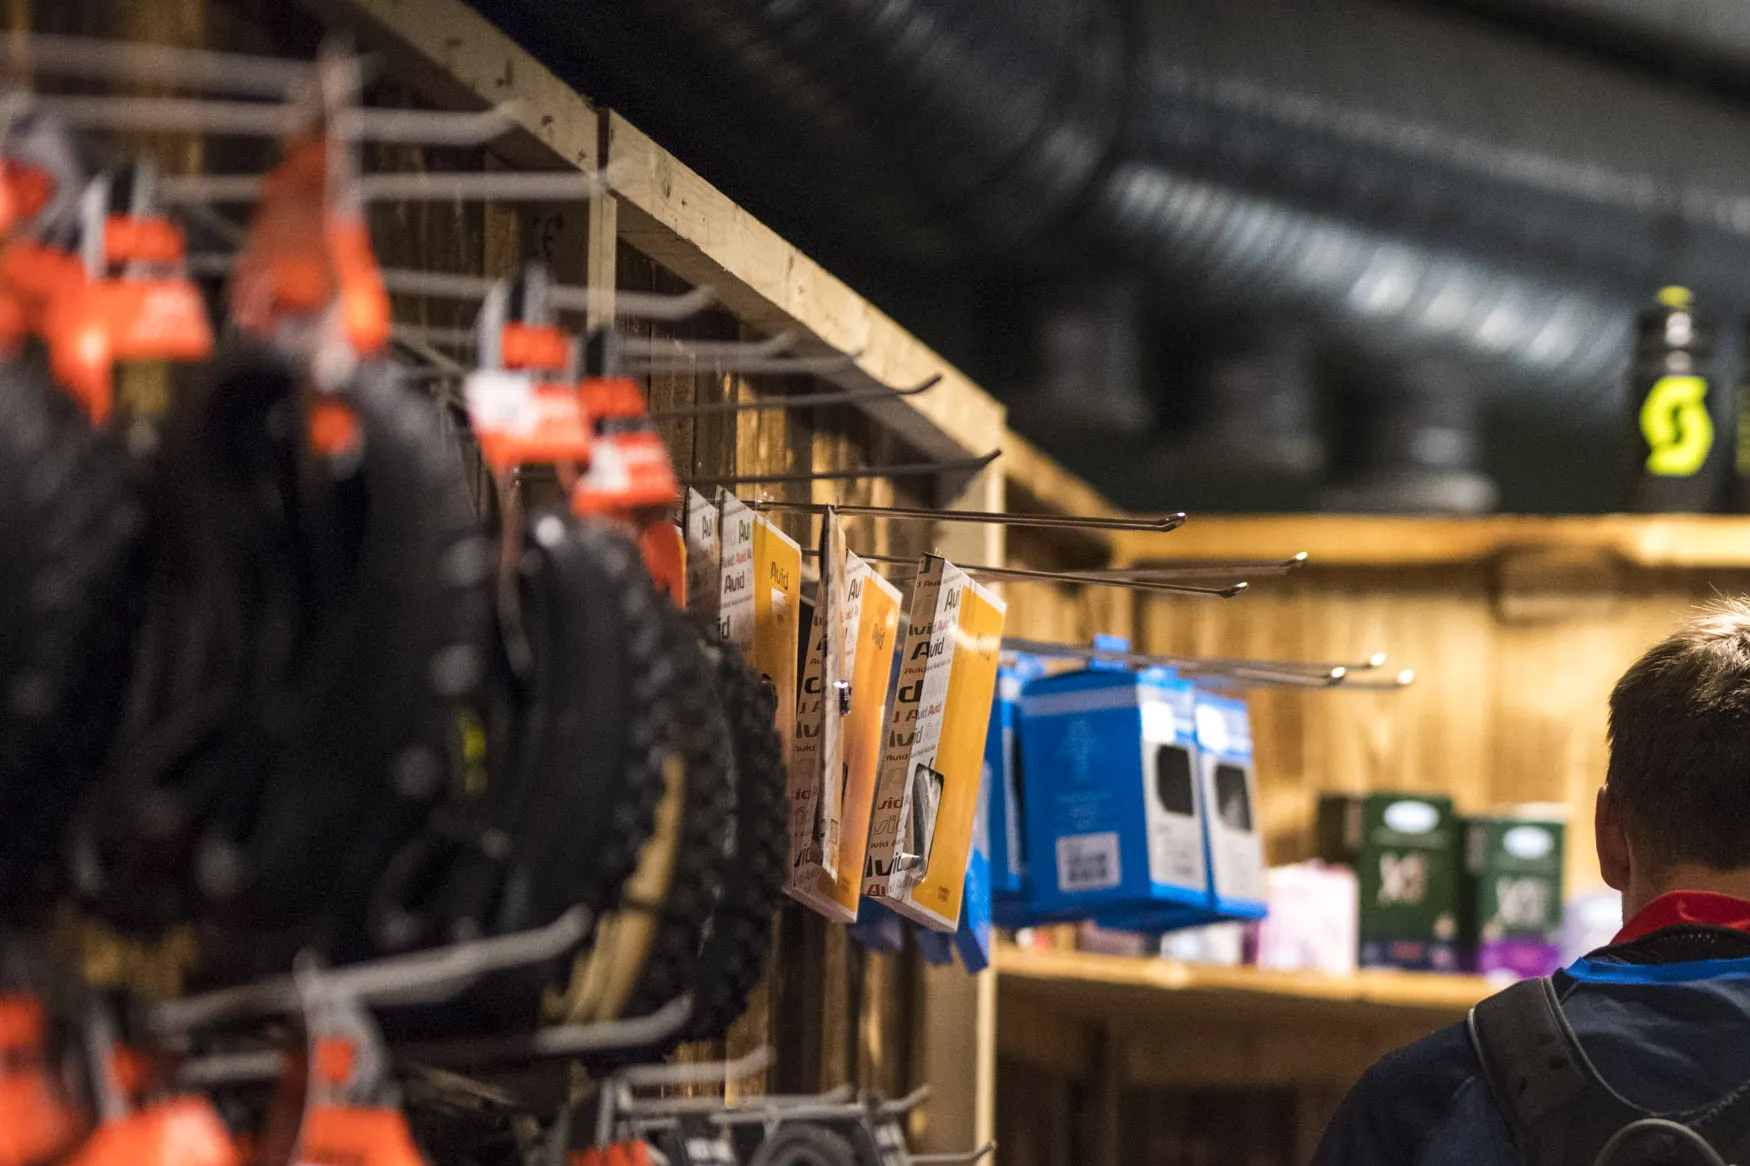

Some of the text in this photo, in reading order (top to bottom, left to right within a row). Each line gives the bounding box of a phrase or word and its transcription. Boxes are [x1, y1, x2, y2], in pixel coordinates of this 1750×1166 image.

[724, 570, 745, 594] Avid
[770, 561, 789, 590] Avid
[910, 636, 945, 660] Avid
